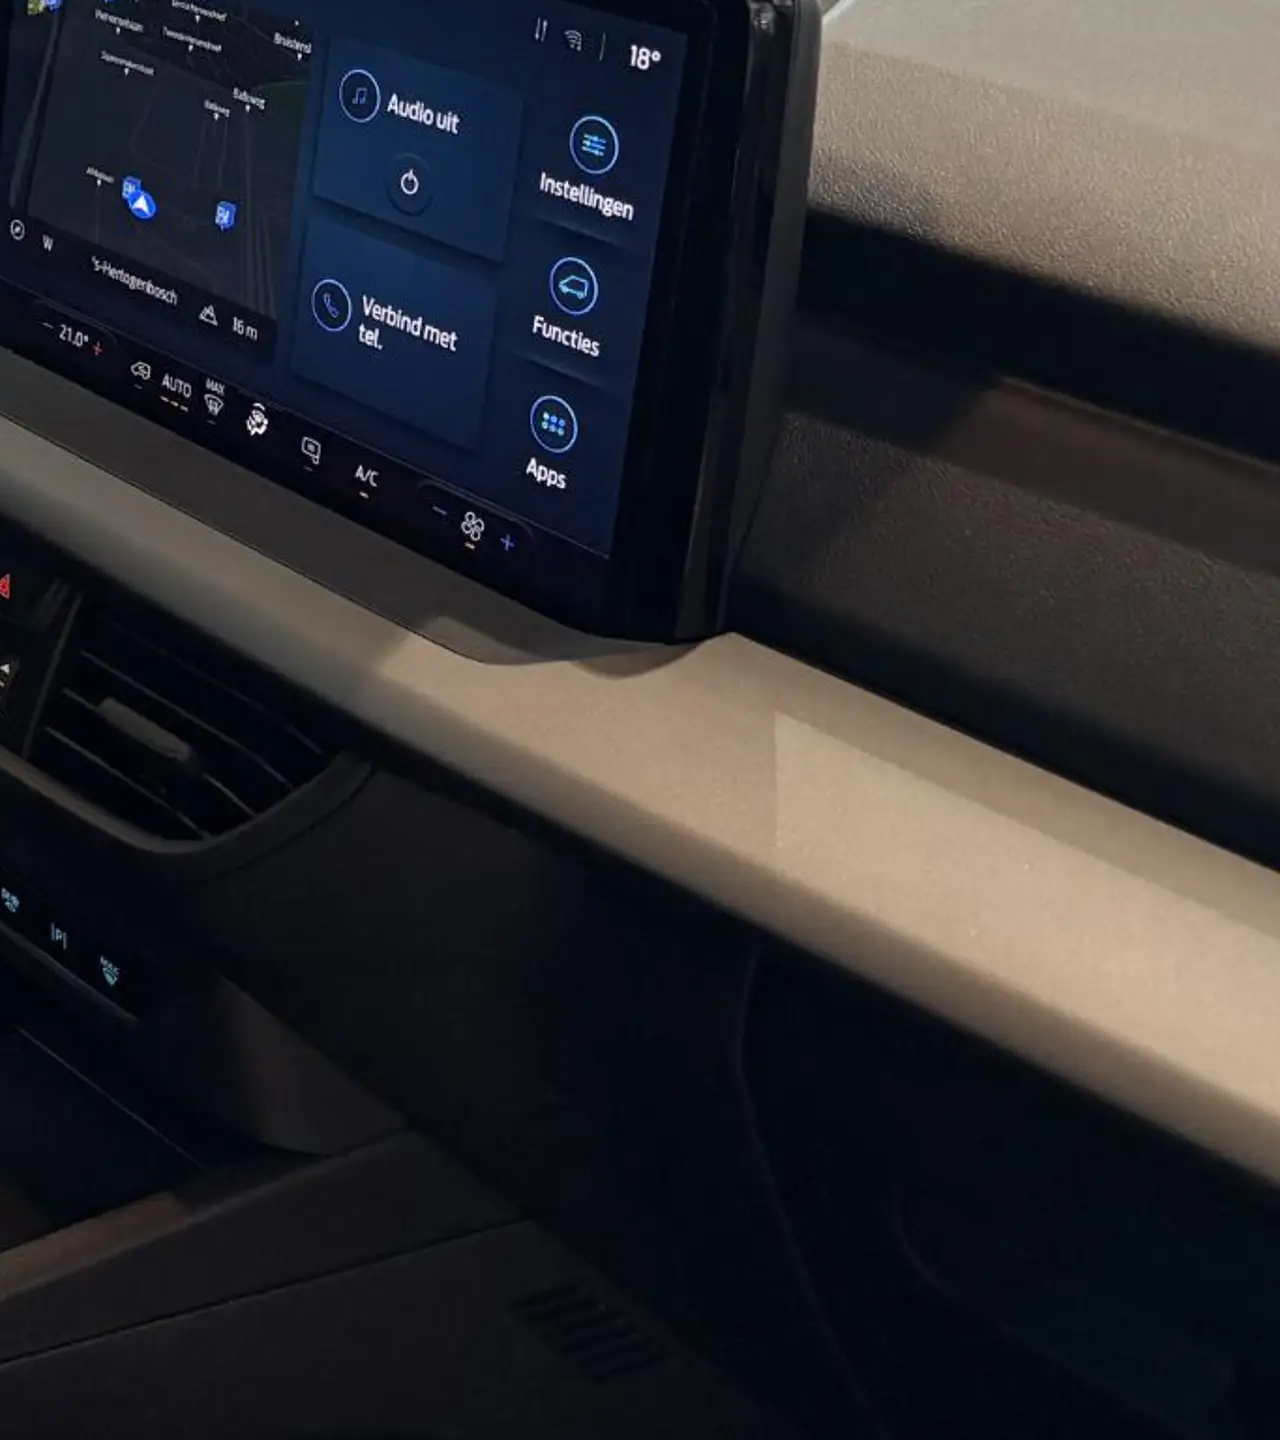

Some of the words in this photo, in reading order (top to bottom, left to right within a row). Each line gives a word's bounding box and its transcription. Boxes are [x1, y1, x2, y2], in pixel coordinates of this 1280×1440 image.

[629, 44, 661, 71] 18°
[387, 93, 434, 127] Audio
[435, 110, 461, 136] uit
[540, 172, 634, 221] Instellingen
[42, 234, 54, 252] W
[232, 316, 245, 336] 16
[245, 325, 258, 341] m
[362, 294, 423, 338] Verbind
[423, 323, 458, 351] met
[358, 323, 383, 351] tel.
[532, 315, 601, 358] Functies
[162, 373, 192, 398] AUTO
[205, 377, 225, 395] MAX
[355, 463, 380, 488] A/C
[526, 456, 568, 490] Apps
